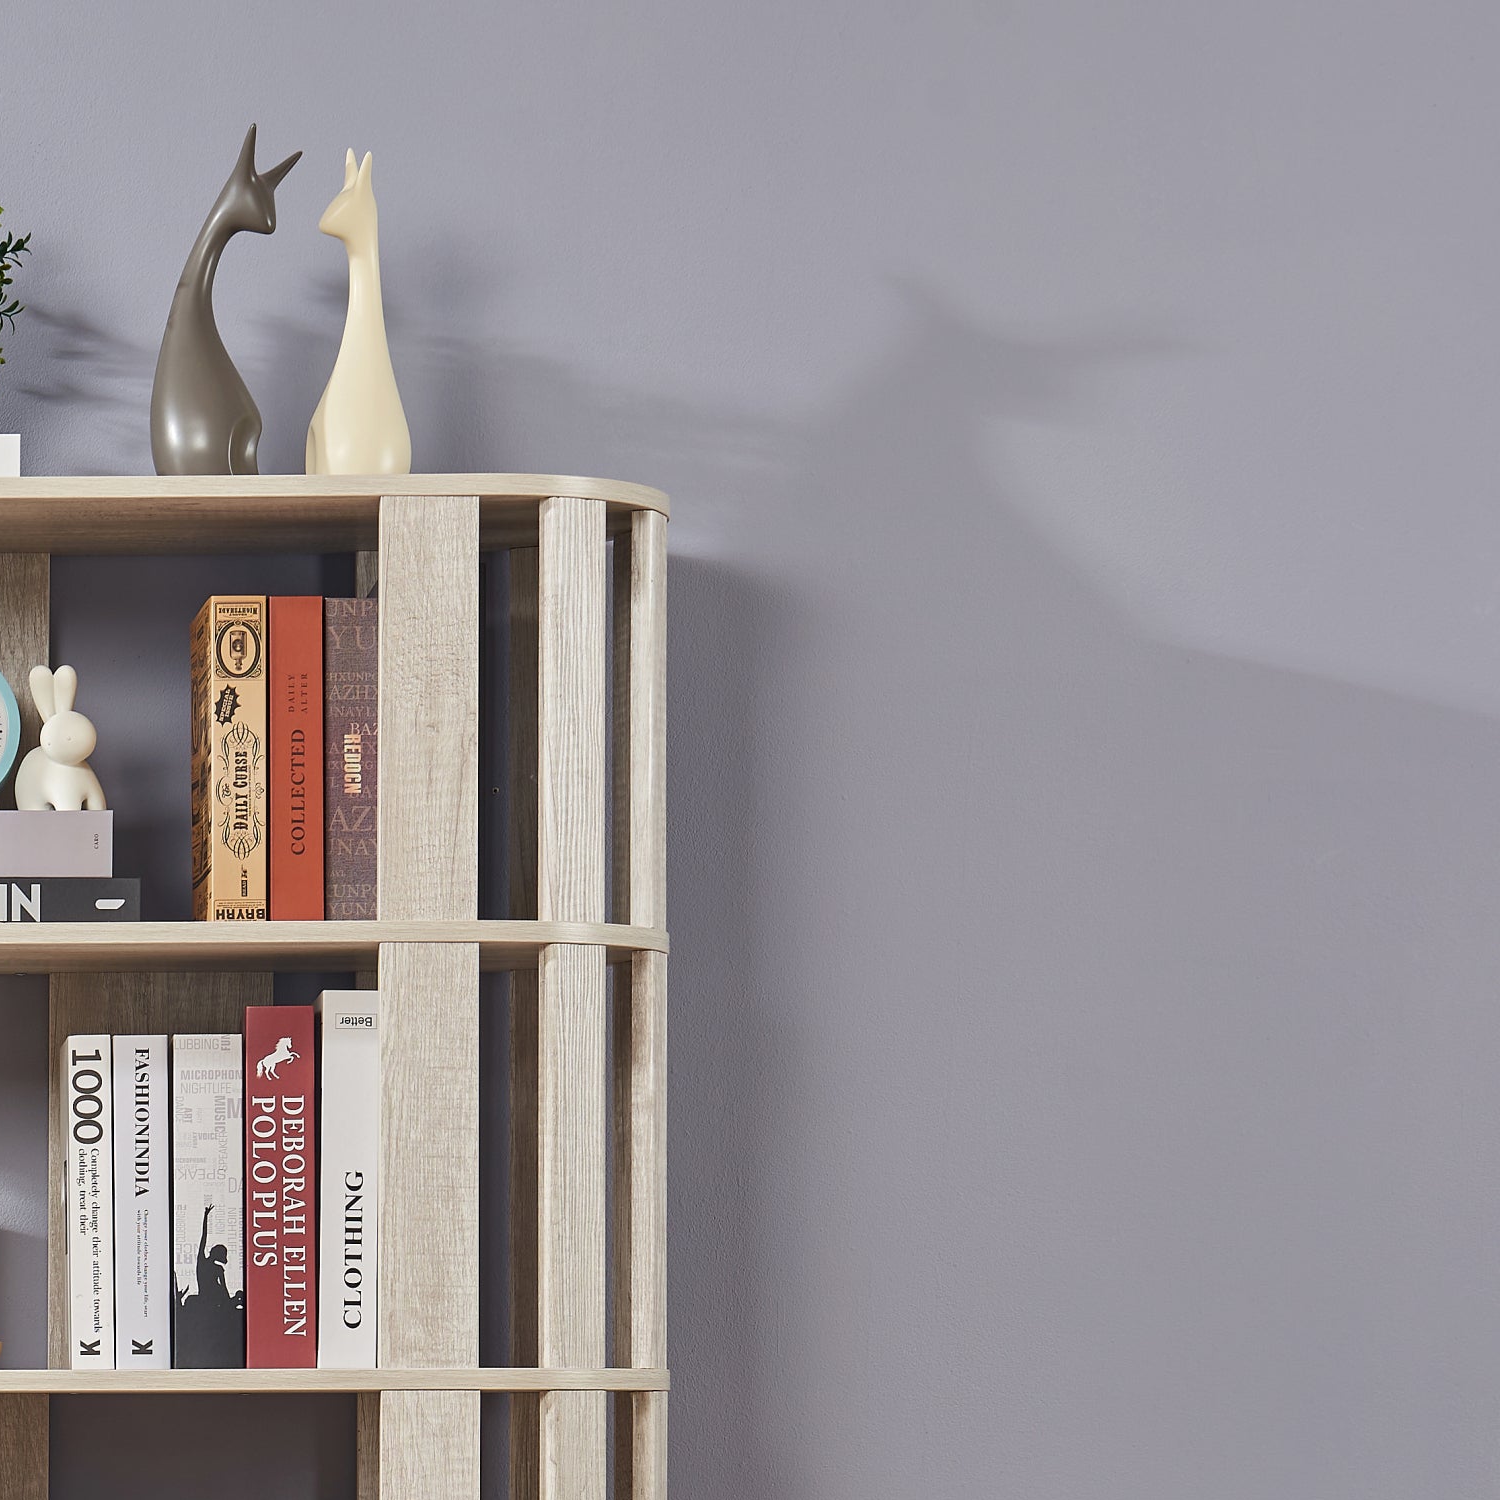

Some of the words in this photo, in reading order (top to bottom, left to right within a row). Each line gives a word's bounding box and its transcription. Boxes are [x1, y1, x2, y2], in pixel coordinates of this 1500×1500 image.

[232, 751, 248, 789] CURSE
[291, 729, 306, 855] COLLECTED
[233, 793, 248, 830] DAILY
[339, 1016, 373, 1027] Better
[71, 1049, 103, 1145] 1000
[180, 1082, 232, 1094] NIGHTLIFE
[134, 1047, 150, 1197] FASHIONINDIA
[214, 1095, 226, 1132] MUSIC
[76, 1148, 88, 1187] clothing,
[88, 1148, 100, 1198] Completely
[281, 1095, 306, 1235] DEBORAH
[79, 1190, 87, 1210] treat
[89, 1201, 101, 1233] change
[79, 1214, 89, 1236] their
[91, 1236, 102, 1258] their
[343, 1171, 364, 1329] CLOTHING
[92, 1260, 102, 1295] attitude
[283, 1246, 307, 1336] ELLEN
[93, 1299, 103, 1333] towards
[80, 1339, 101, 1355] K
[132, 1339, 153, 1355] K
